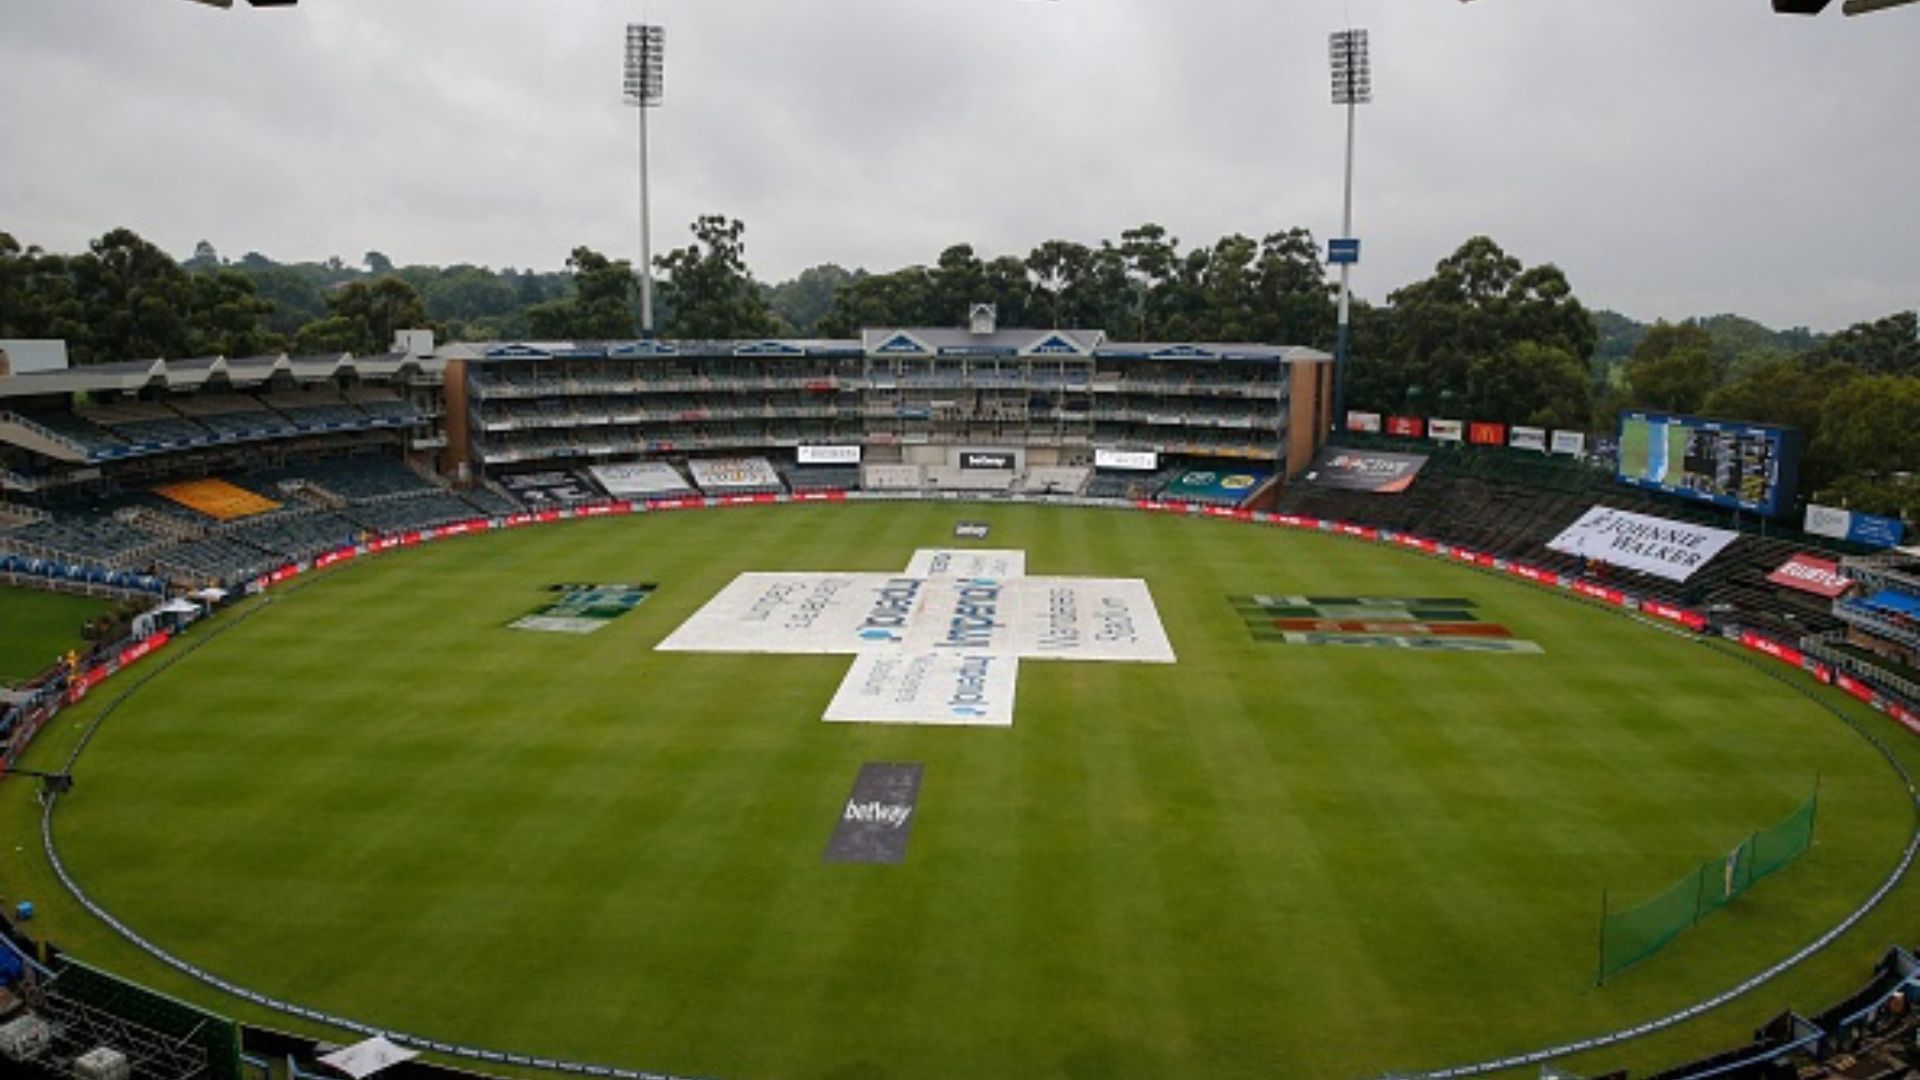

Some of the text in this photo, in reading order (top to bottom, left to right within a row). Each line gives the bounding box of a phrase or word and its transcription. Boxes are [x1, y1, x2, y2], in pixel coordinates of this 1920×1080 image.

[1598, 517, 1707, 549] JOHNNIE
[1611, 535, 1702, 567] WALKER
[844, 798, 912, 828] betway
